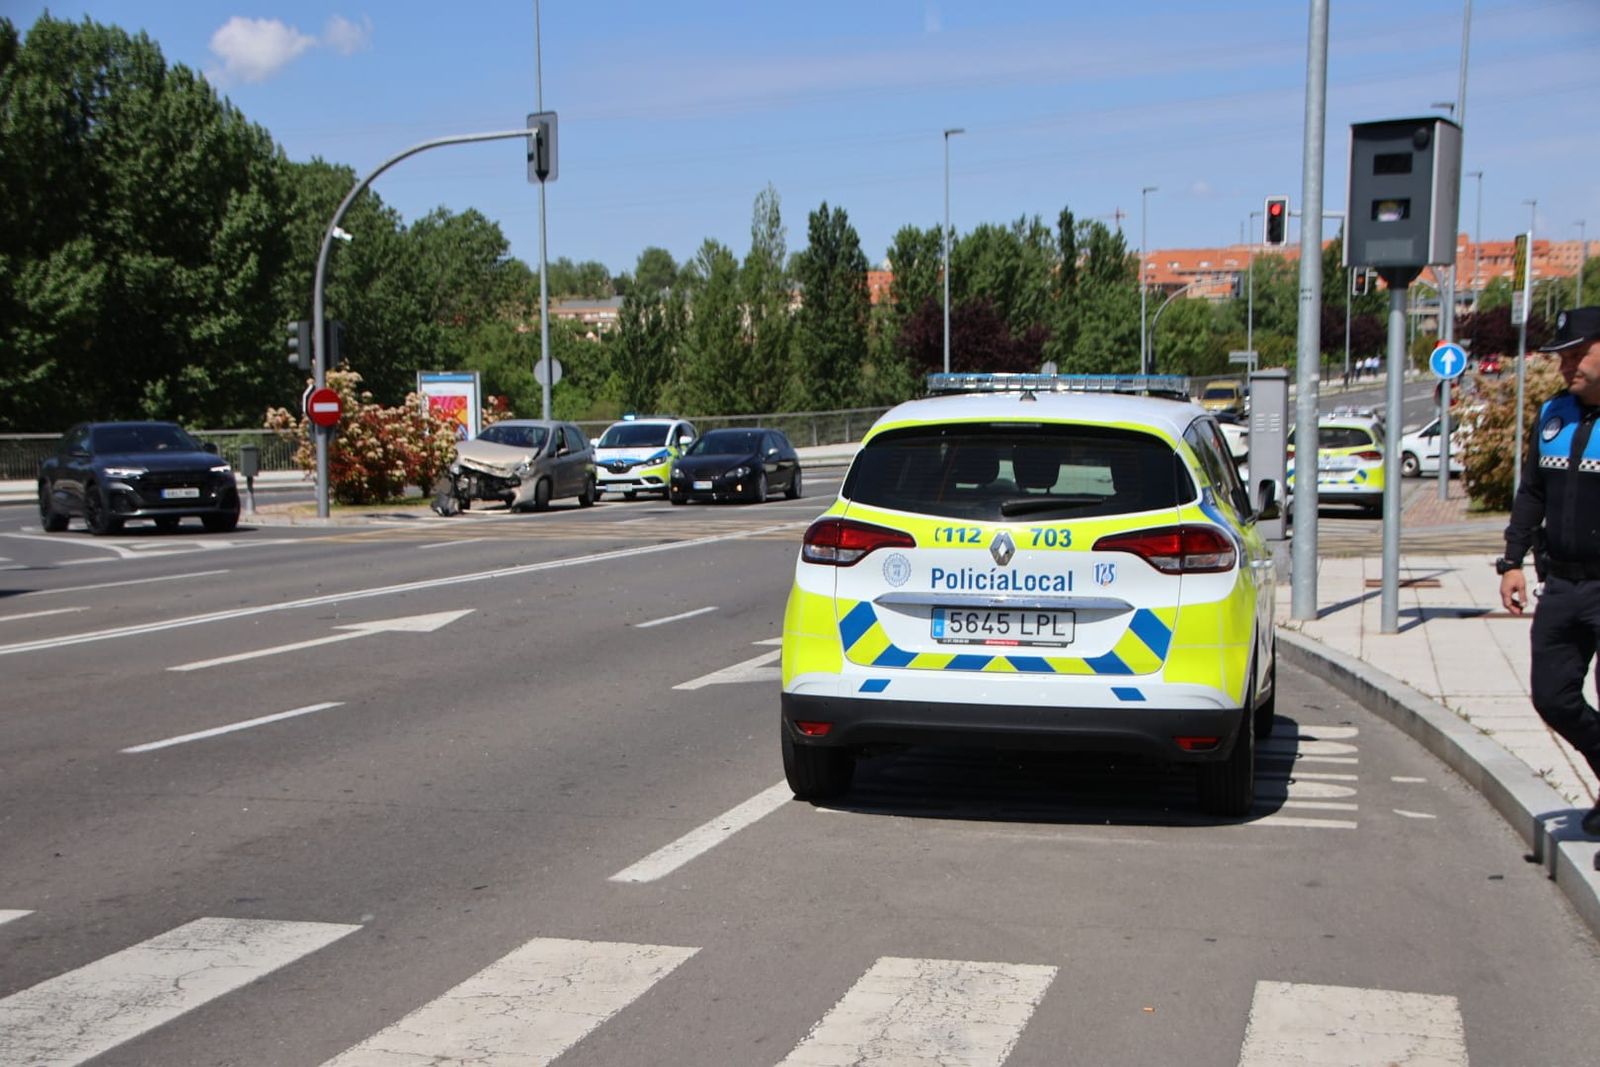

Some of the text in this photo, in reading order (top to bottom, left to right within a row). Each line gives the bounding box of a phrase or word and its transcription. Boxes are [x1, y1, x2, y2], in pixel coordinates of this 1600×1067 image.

[1030, 528, 1073, 547] 703
[949, 611, 1011, 635] 5645
[1020, 613, 1066, 636] LPL
